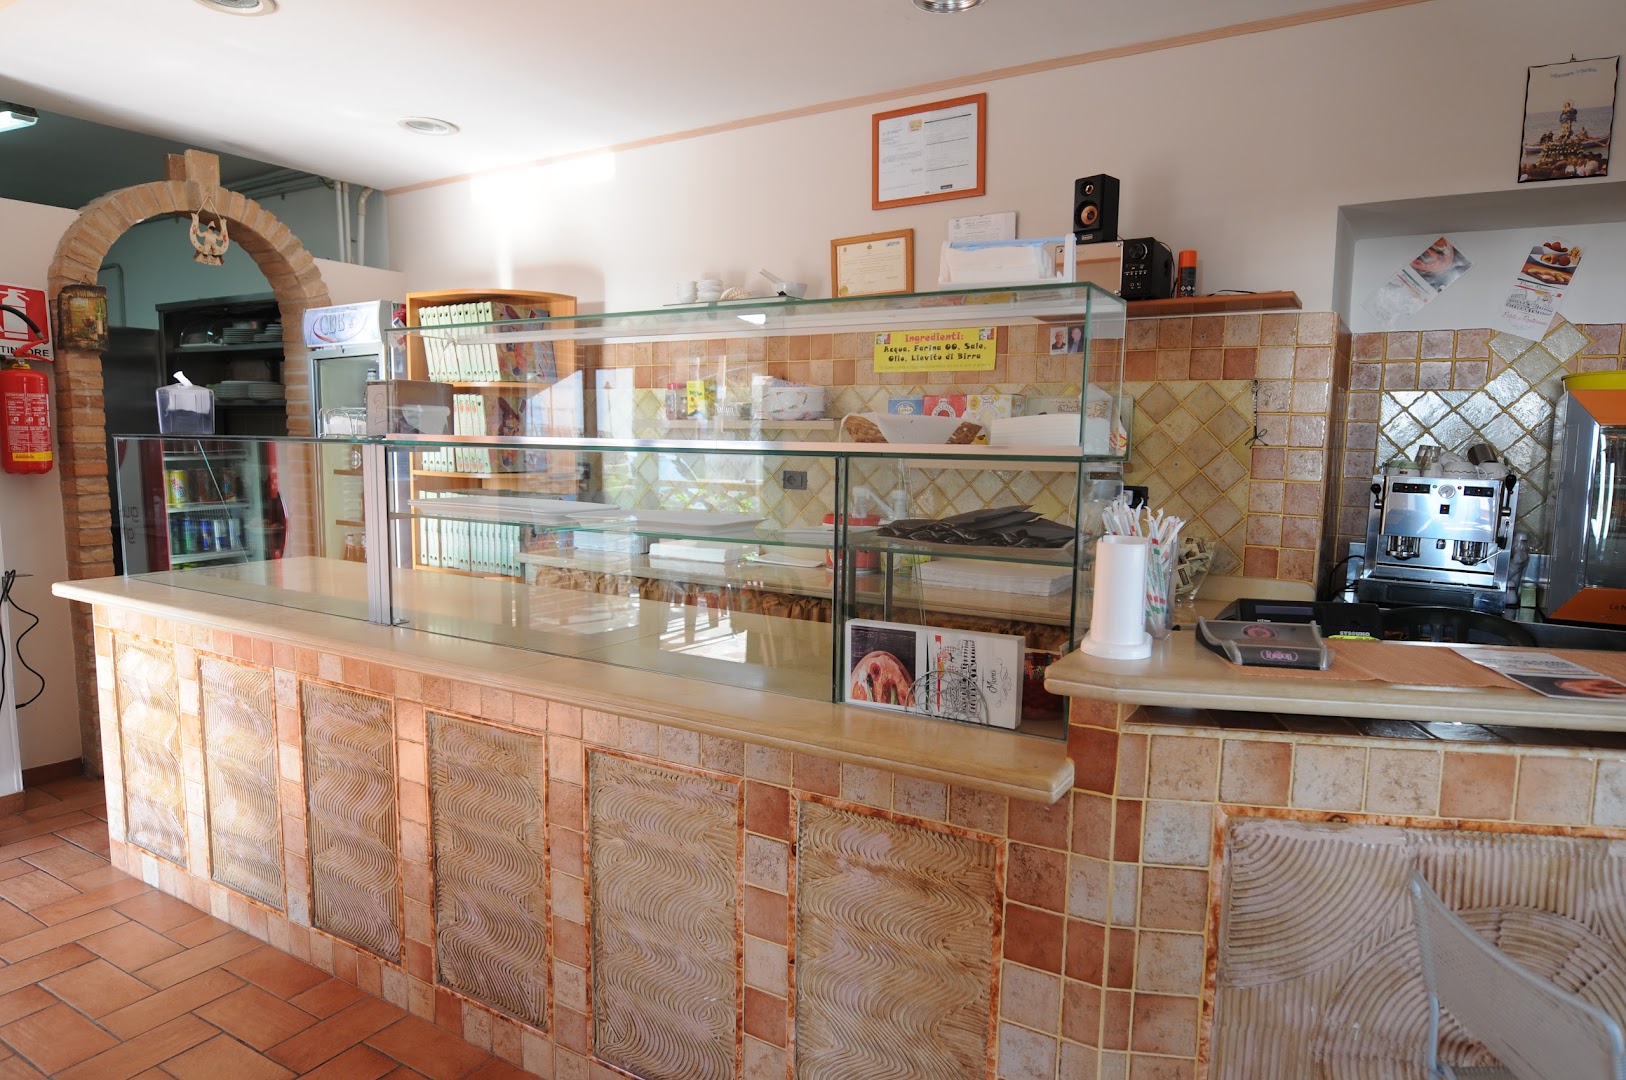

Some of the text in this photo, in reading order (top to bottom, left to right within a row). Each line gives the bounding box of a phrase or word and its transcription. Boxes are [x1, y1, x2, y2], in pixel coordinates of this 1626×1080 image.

[905, 332, 964, 344] Ingredienti:
[0, 345, 50, 358] TINRE
[914, 344, 941, 352] Farina
[912, 353, 942, 361] Lievito
[958, 352, 981, 360] Birra
